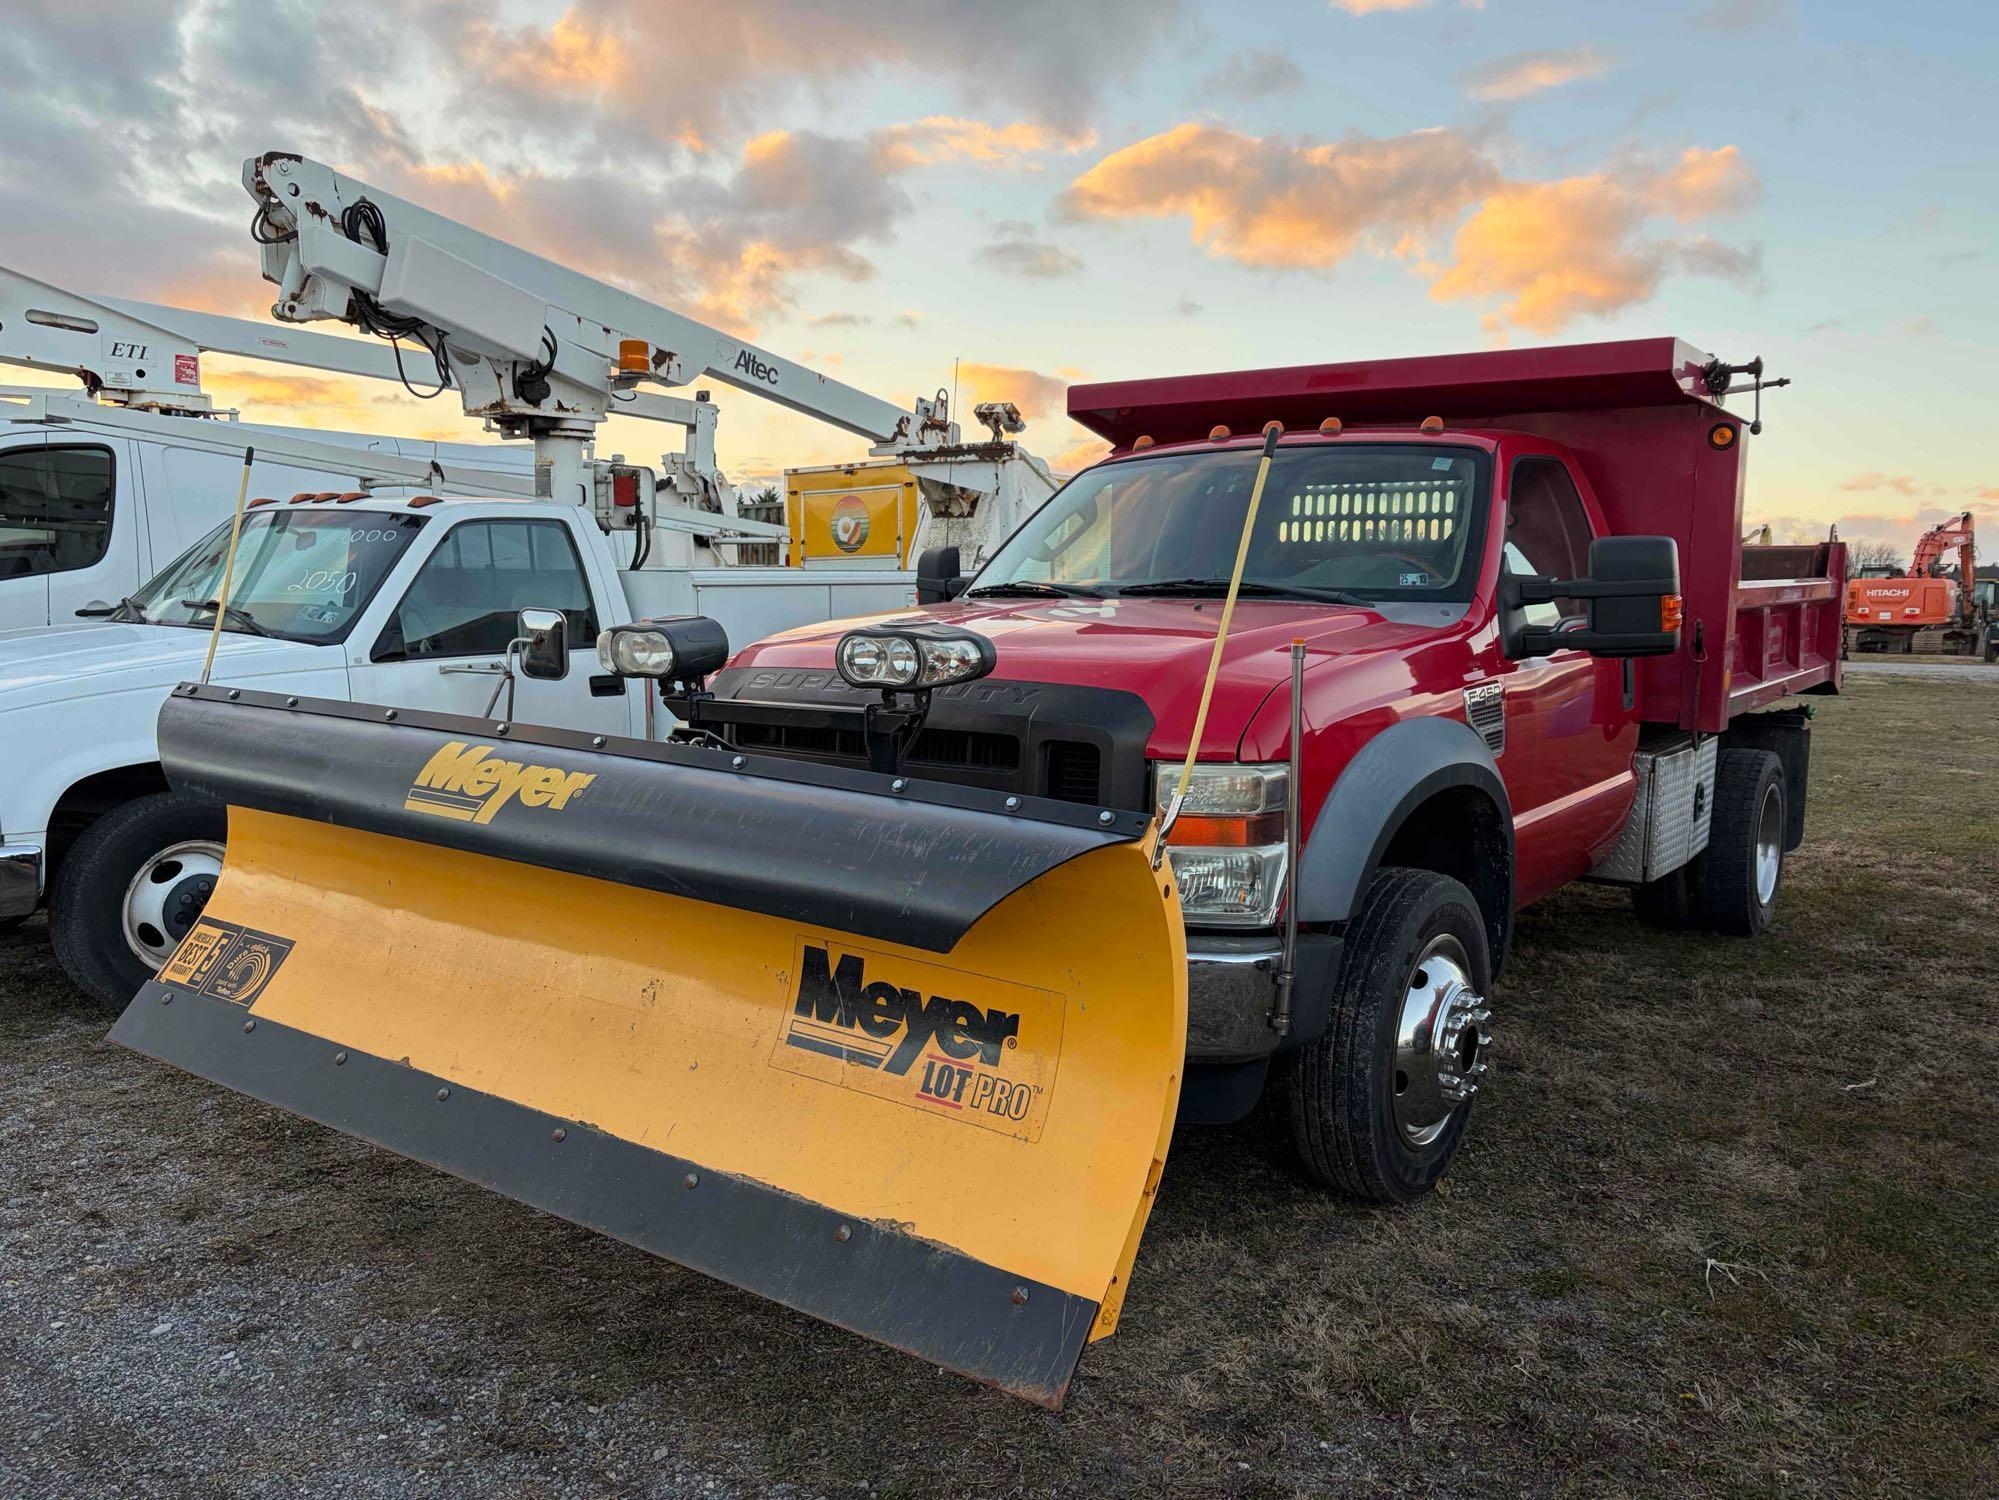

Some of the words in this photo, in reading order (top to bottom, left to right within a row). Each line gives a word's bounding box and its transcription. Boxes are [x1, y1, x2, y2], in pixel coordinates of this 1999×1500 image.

[109, 341, 149, 361] ETI
[734, 349, 779, 385] Altec
[287, 569, 357, 594] 2050
[1866, 588, 1910, 597] HITACHI
[749, 671, 873, 693] SUPE
[937, 682, 1042, 705] UTY
[413, 741, 597, 825] Meyer
[170, 963, 193, 977] WARRANTY
[177, 942, 208, 966] BEST
[201, 938, 229, 973] 5
[794, 944, 1020, 1077] Meyer
[920, 1059, 973, 1103] LOT
[970, 1073, 1032, 1121] PRO
